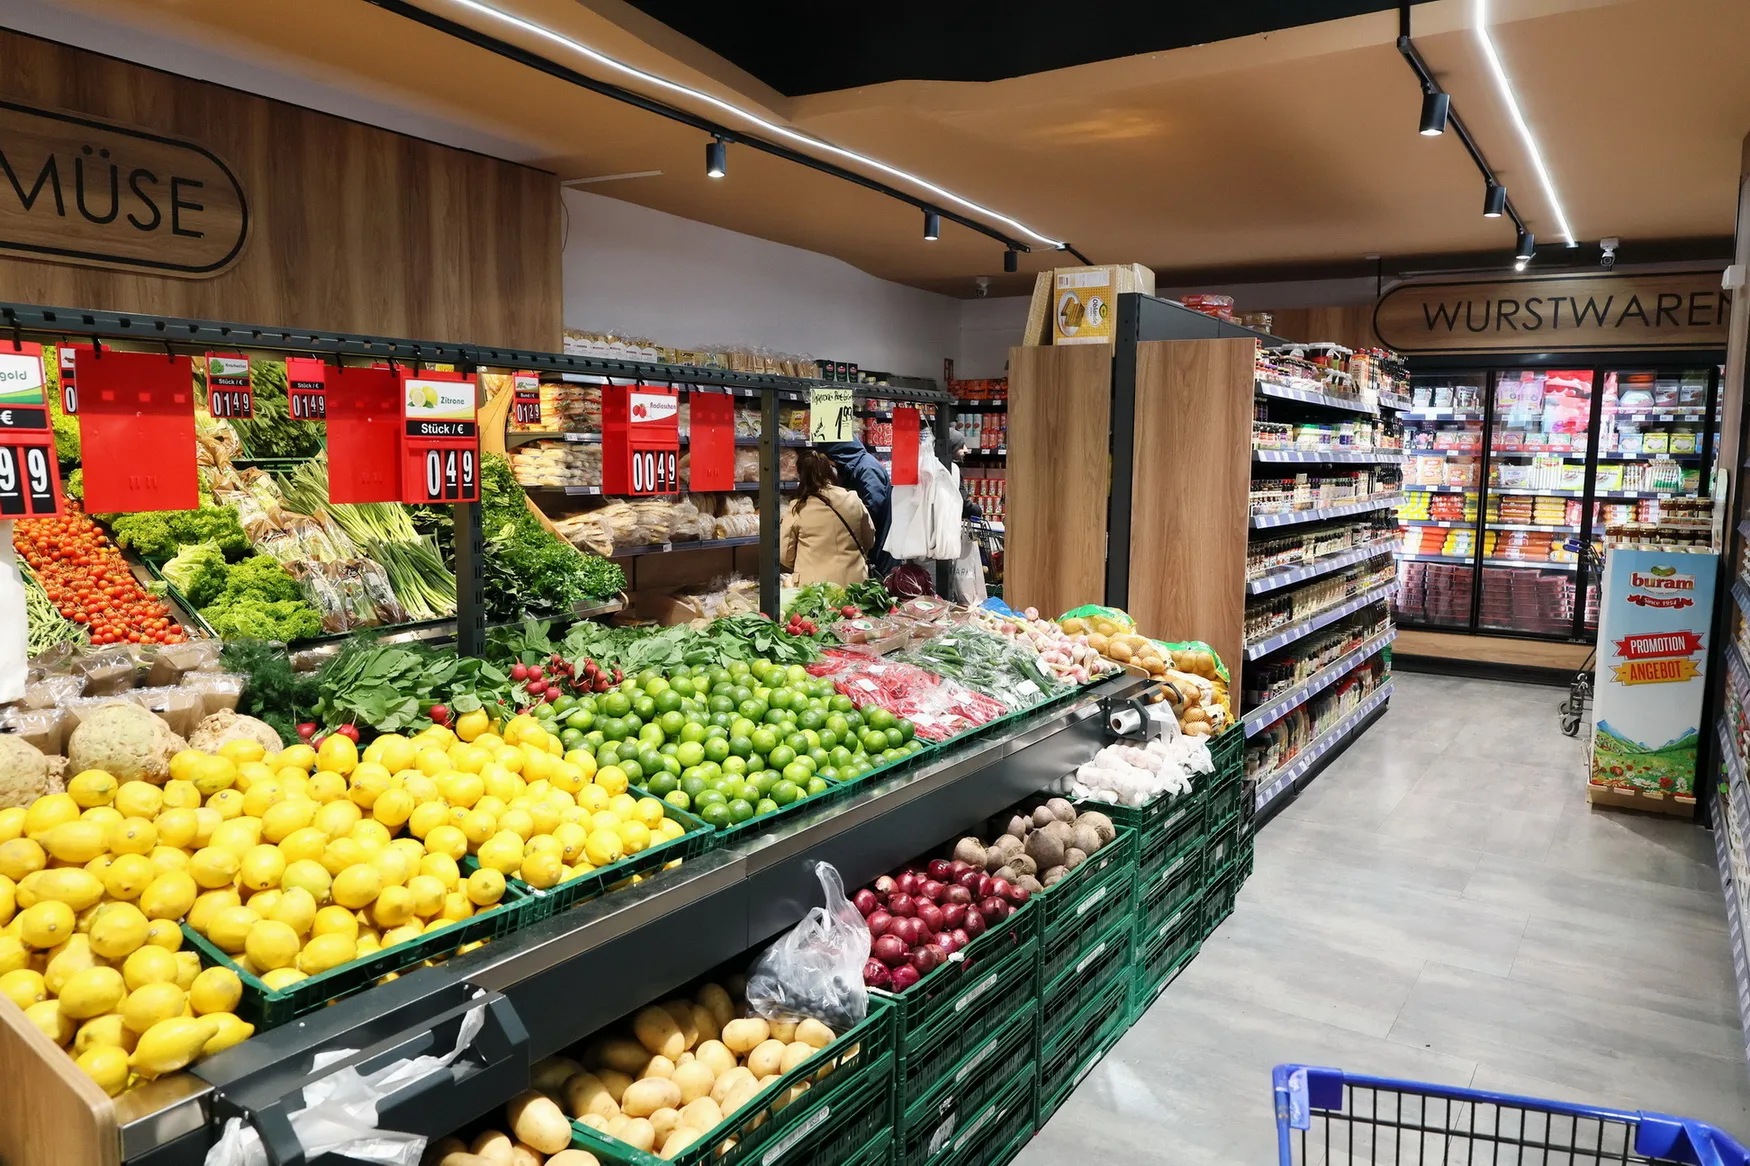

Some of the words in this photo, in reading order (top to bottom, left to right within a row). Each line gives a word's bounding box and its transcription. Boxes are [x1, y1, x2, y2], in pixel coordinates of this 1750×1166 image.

[0, 145, 205, 238] MÜSE
[213, 392, 249, 417] 0149
[293, 394, 325, 418] 0149
[440, 396, 465, 405] Zitrone
[0, 410, 14, 425] €
[421, 423, 450, 434] Stück
[457, 424, 464, 434] €
[426, 450, 473, 496] 049
[633, 453, 676, 491] 0049
[1632, 573, 1695, 590] buram
[1644, 597, 1660, 606] Since
[1662, 599, 1677, 607] 1954
[1630, 636, 1686, 654] PROMOTION
[1631, 661, 1681, 680] ANGEBOT
